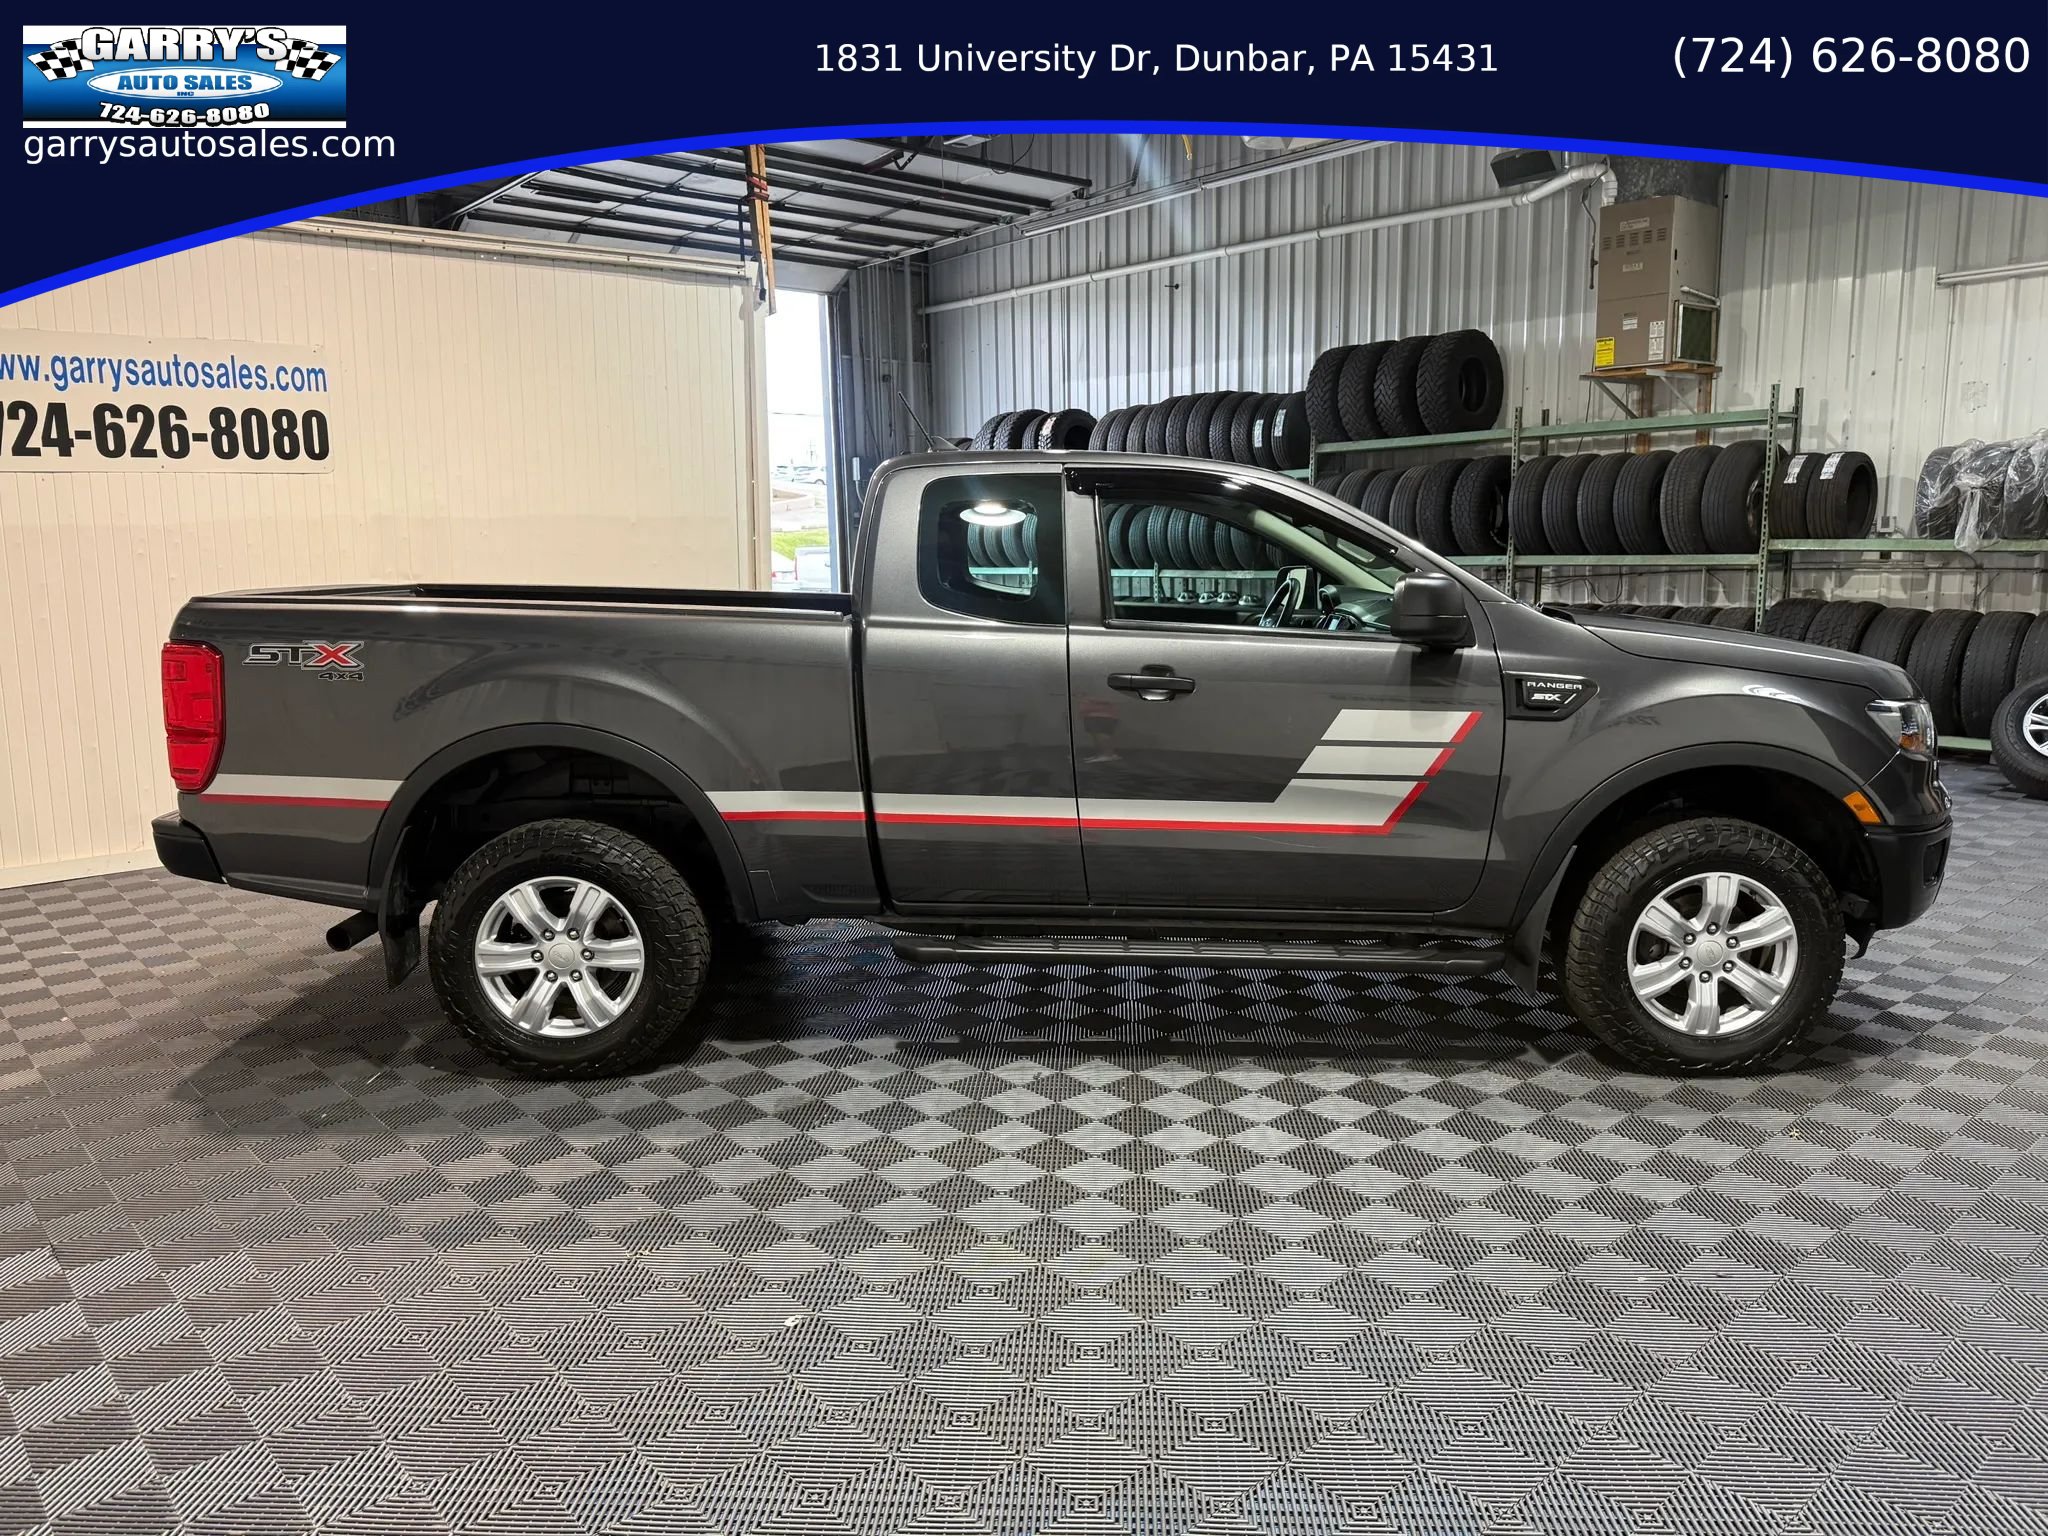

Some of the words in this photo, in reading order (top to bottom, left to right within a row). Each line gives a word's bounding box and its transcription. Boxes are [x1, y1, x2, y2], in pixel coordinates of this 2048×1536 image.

[0, 400, 330, 460] 24-626-8080
[242, 640, 365, 671] STX
[1527, 681, 1583, 690] RANGER
